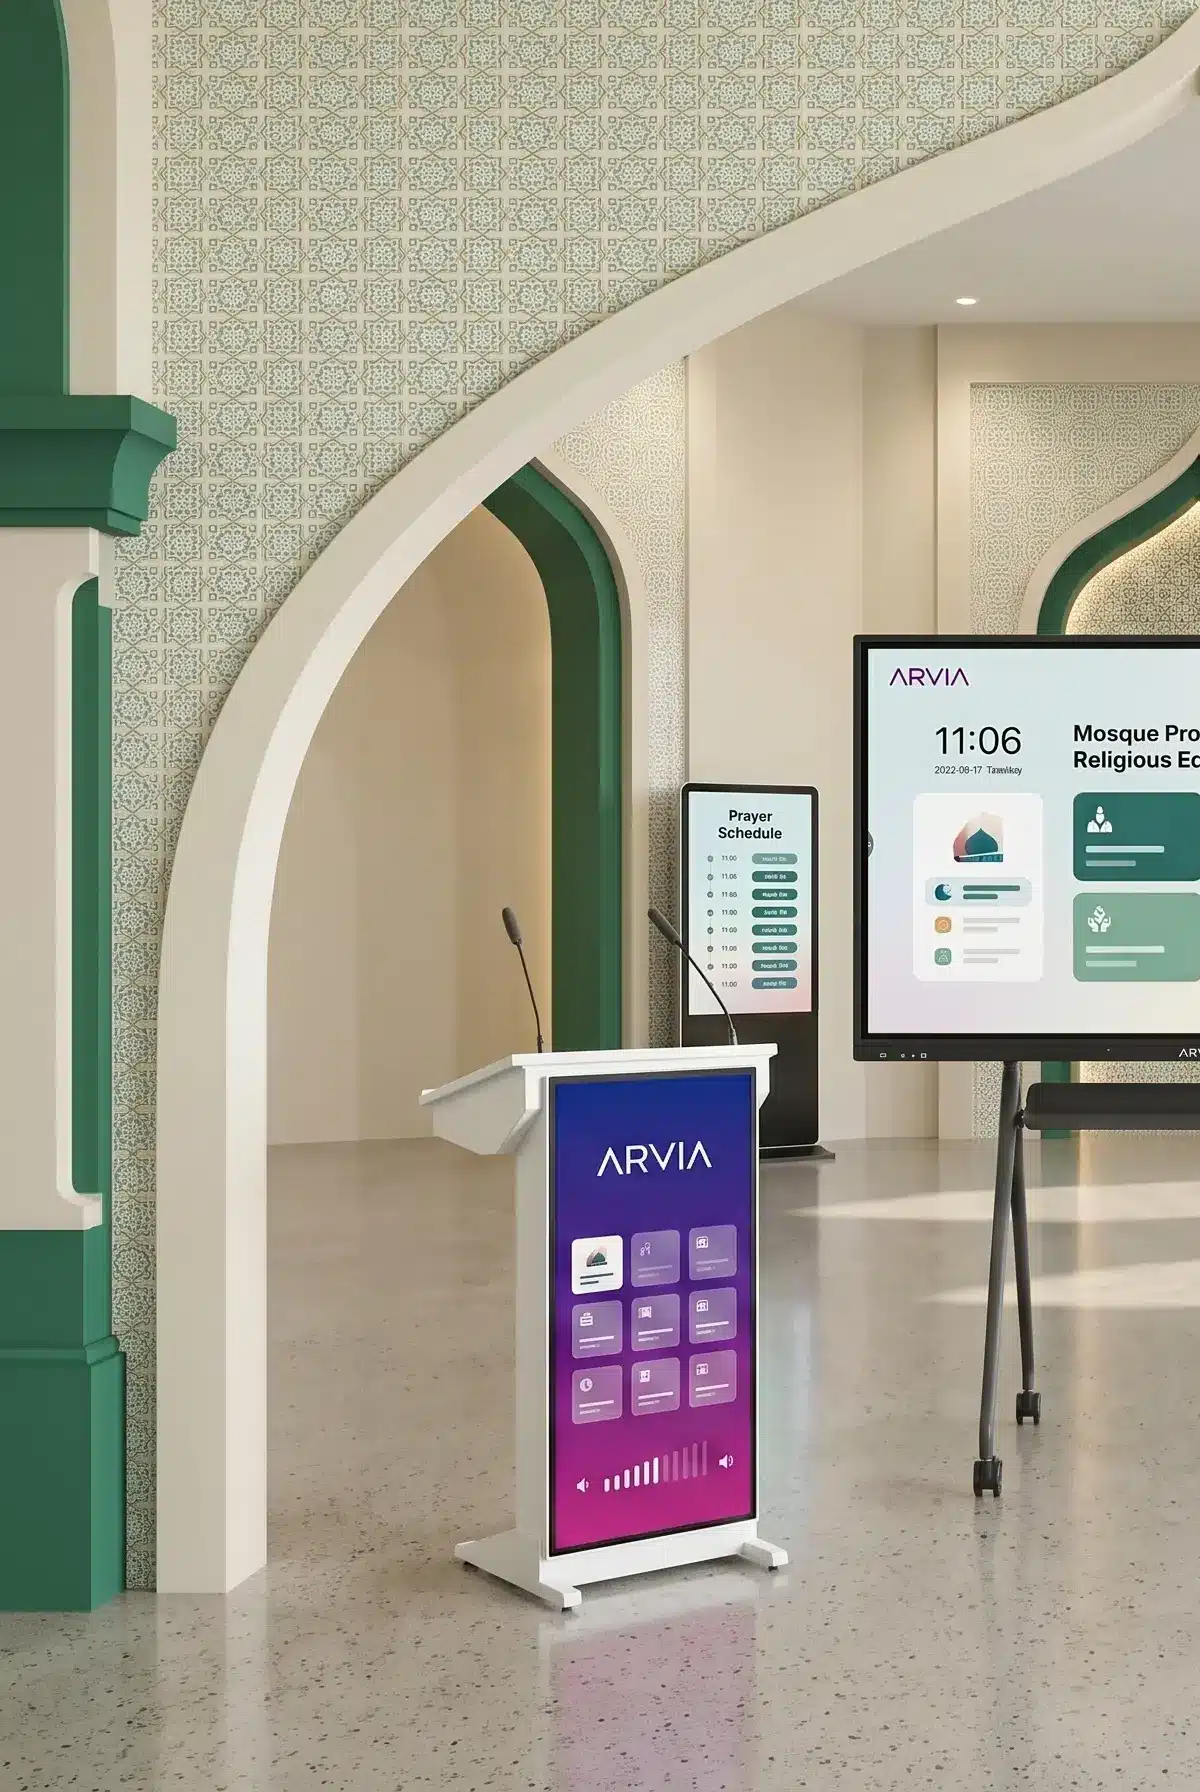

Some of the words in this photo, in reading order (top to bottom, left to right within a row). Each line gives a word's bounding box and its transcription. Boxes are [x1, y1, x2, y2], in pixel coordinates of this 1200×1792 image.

[890, 668, 969, 686] ARVIA
[935, 726, 1021, 755] 11:06
[1073, 725, 1160, 746] Mosque
[1073, 751, 1172, 773] Religious
[728, 809, 773, 824] Prayer
[717, 826, 783, 840] Schedule
[597, 1140, 712, 1177] ARVIA
